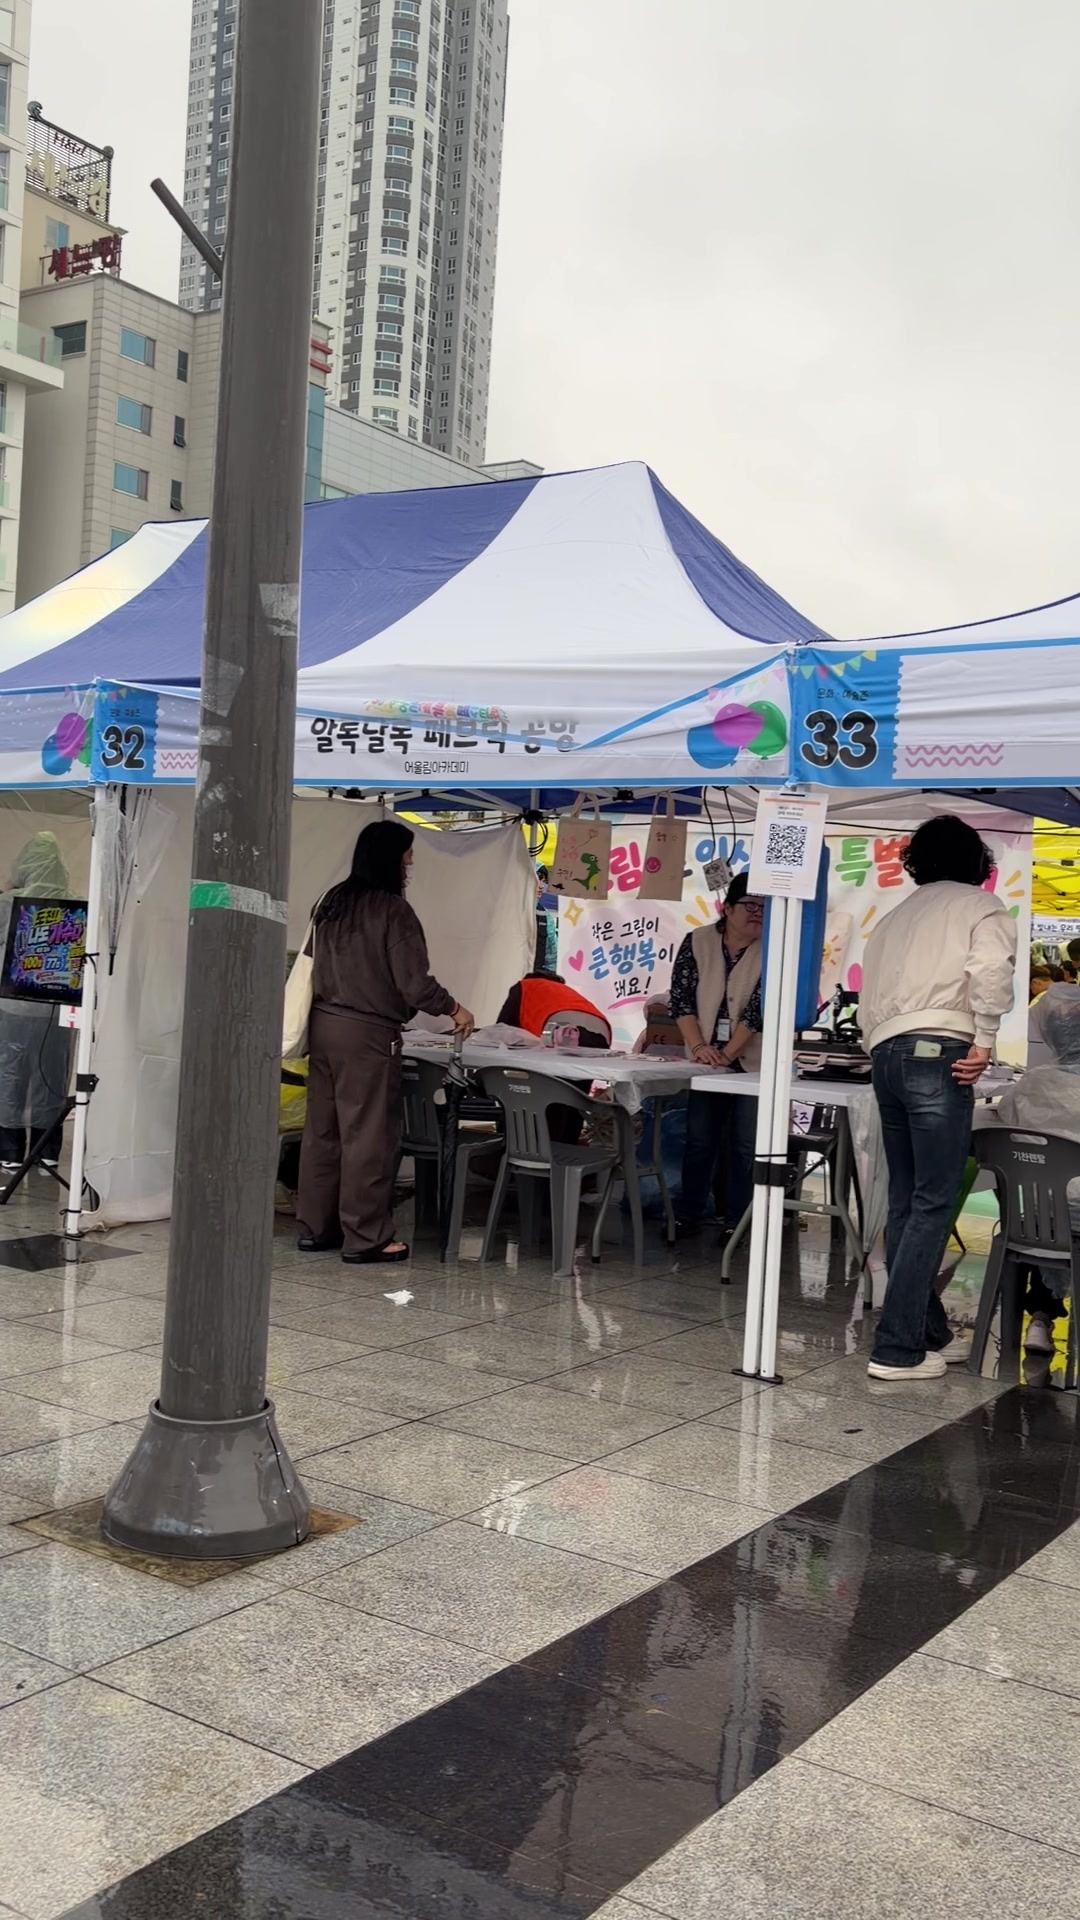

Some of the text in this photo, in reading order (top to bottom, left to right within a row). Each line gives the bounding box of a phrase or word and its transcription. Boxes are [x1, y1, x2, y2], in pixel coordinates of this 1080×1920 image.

[101, 725, 146, 770] 32
[800, 709, 879, 770] 33
[405, 760, 469, 775] 어울림아카데미
[620, 916, 659, 938] 그림이
[1012, 1150, 1046, 1165] 기찬렌탈
